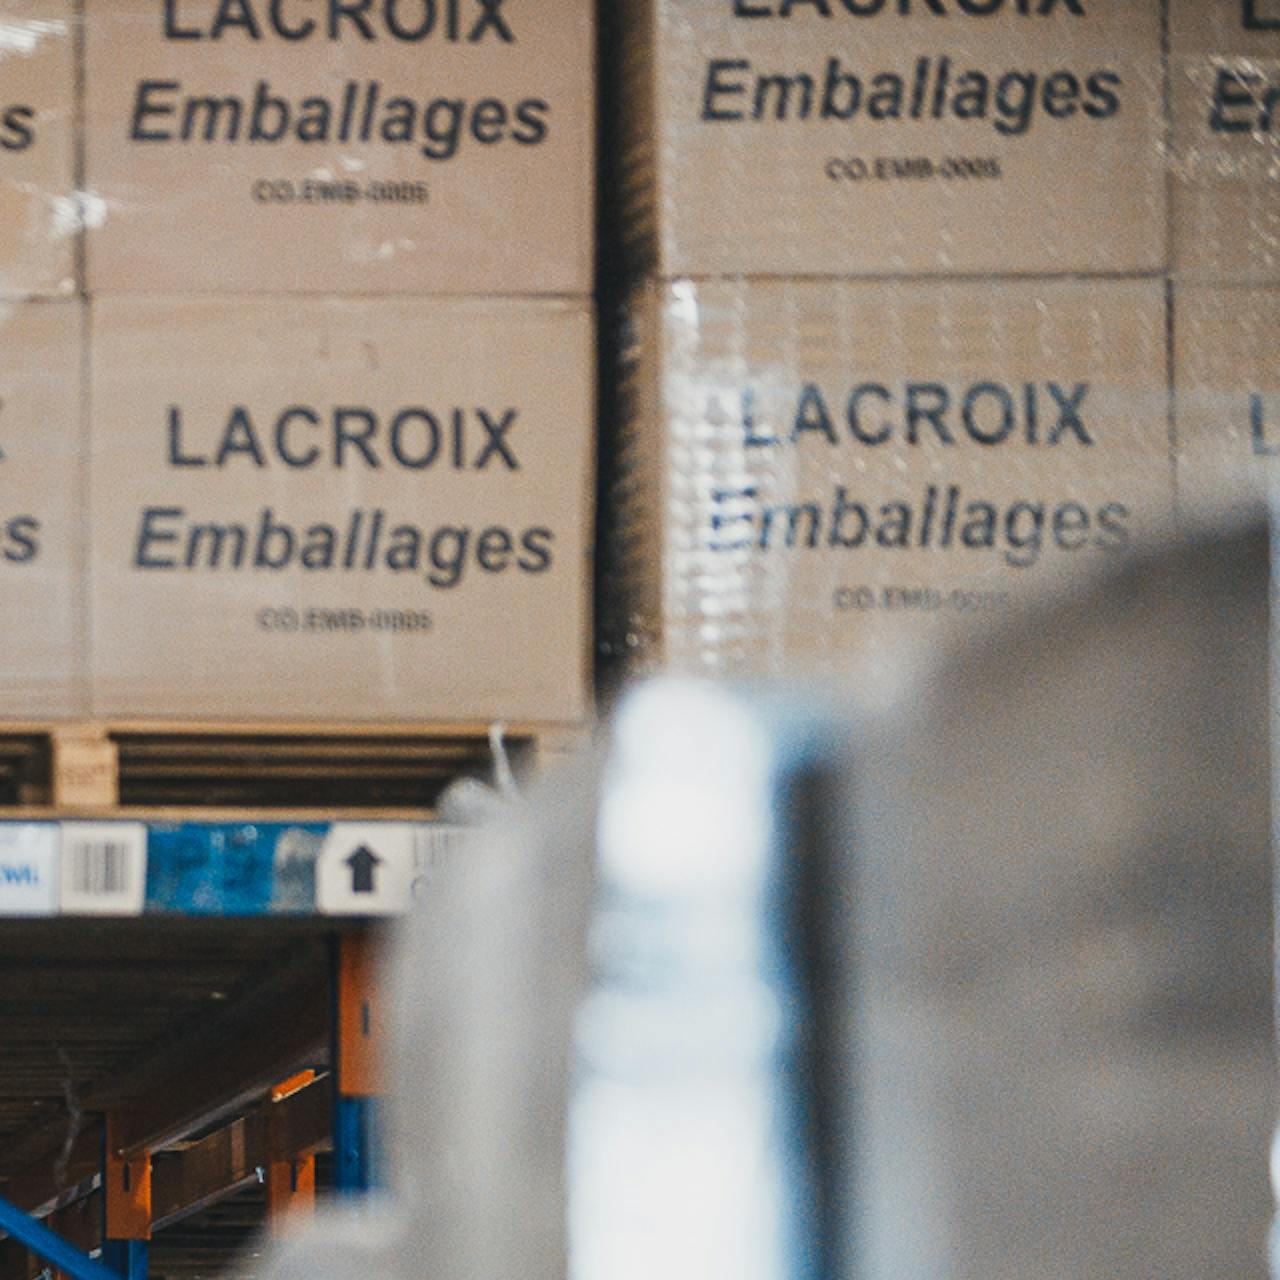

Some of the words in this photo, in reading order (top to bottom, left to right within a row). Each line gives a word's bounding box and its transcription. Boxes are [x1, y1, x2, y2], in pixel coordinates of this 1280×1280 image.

[129, 80, 550, 162] Emballages
[699, 57, 1124, 137] Emballages
[165, 405, 522, 471] LACROIX
[741, 382, 1096, 448] LACROIX
[132, 507, 555, 590] Emballages
[707, 485, 1131, 568] Emballages
